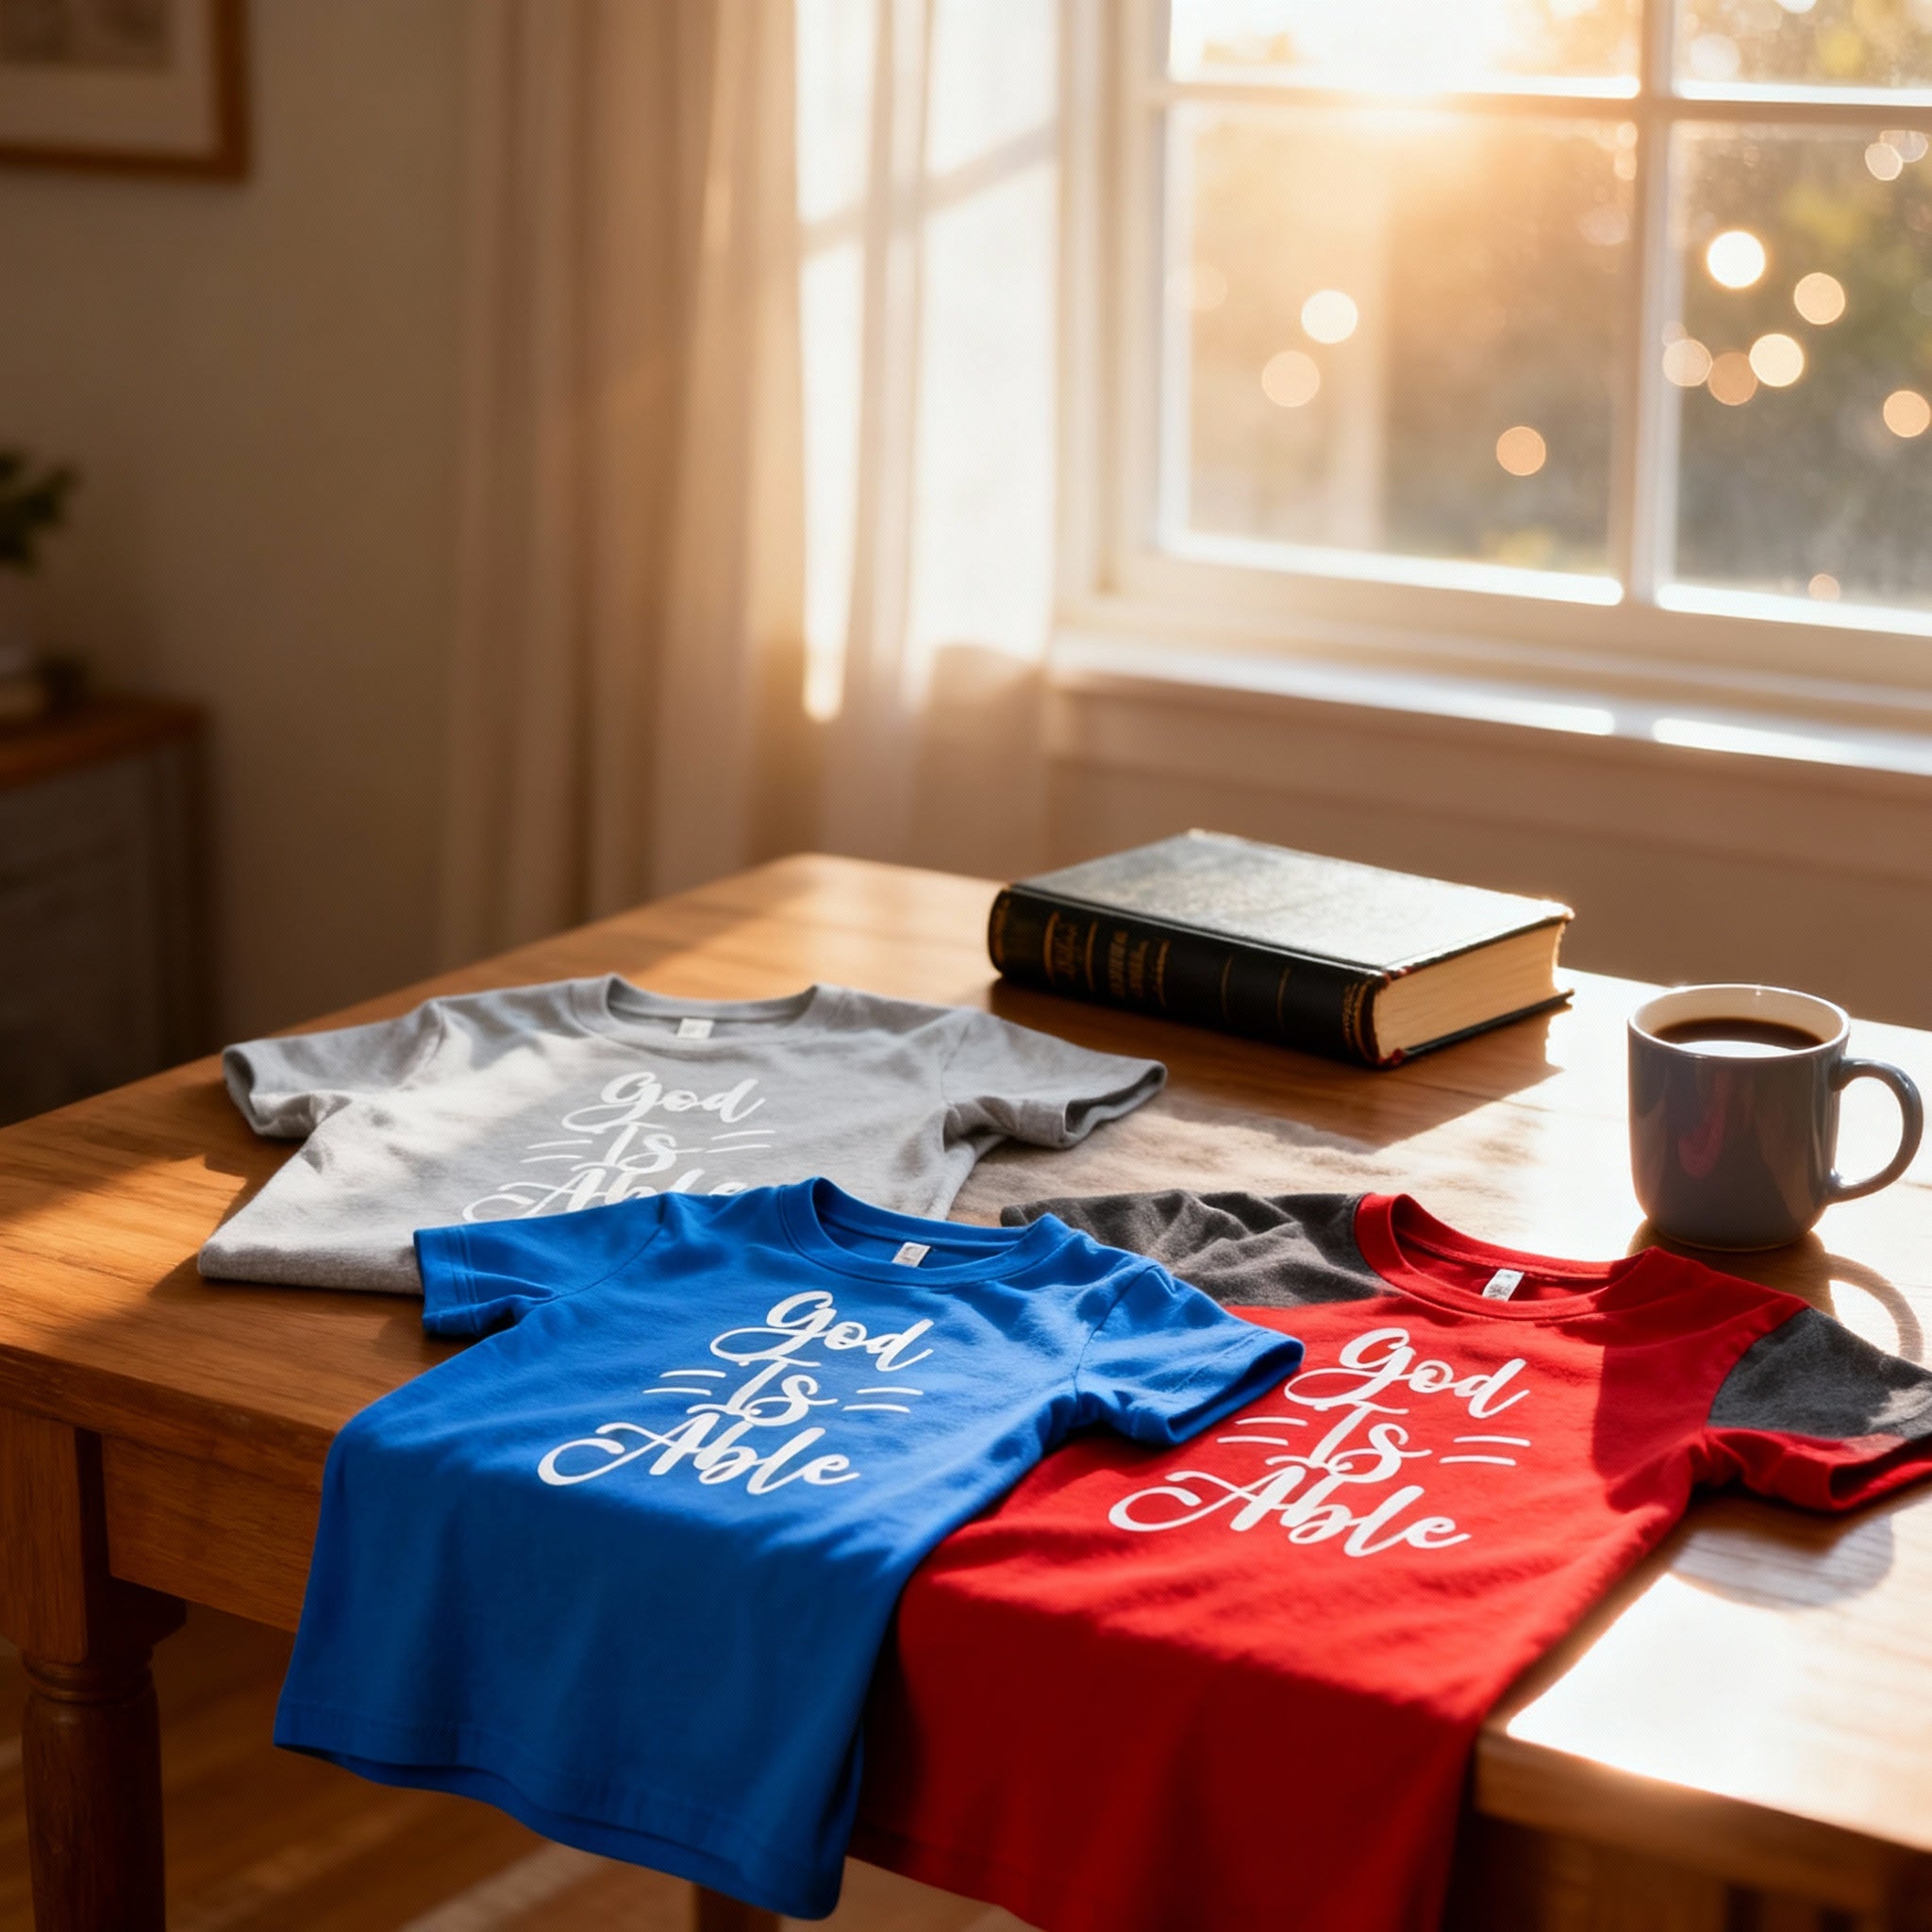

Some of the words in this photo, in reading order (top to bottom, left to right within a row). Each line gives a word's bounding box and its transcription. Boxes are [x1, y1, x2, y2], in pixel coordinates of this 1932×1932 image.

[562, 1072, 765, 1133] God
[710, 1291, 934, 1372] God
[1284, 1327, 1530, 1419] God
[538, 1413, 860, 1495] Able
[1108, 1465, 1472, 1557] Able
